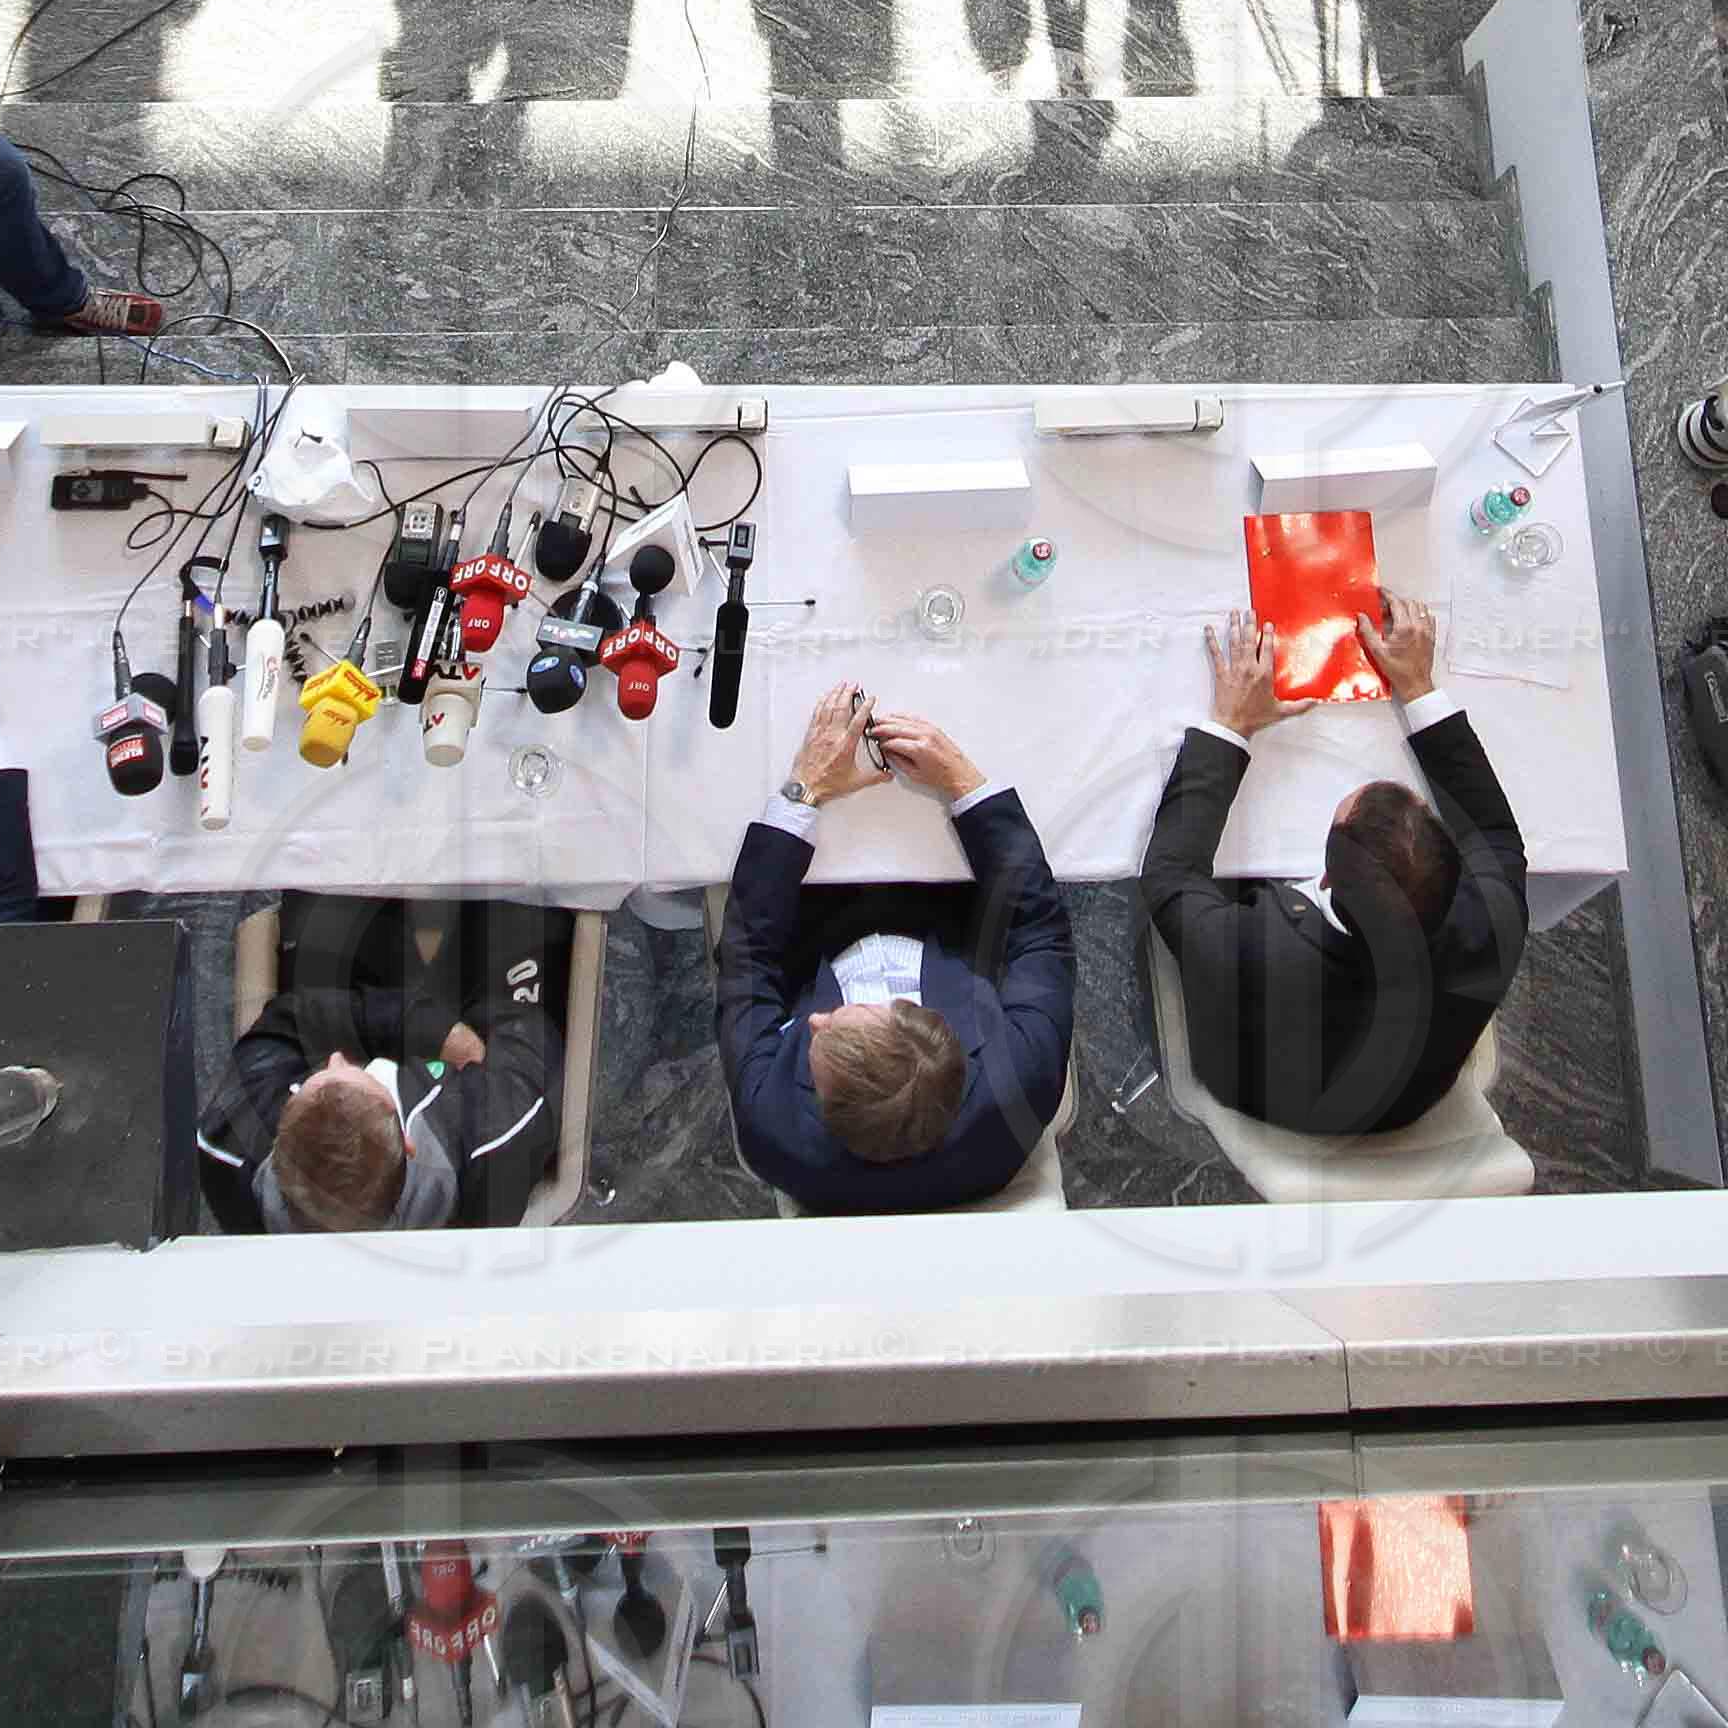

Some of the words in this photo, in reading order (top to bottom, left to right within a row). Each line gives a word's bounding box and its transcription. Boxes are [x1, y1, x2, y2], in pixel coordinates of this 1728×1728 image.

[453, 559, 487, 584] ORF
[488, 563, 528, 592] ORF
[603, 628, 642, 658] ORF
[643, 630, 677, 661] ORF
